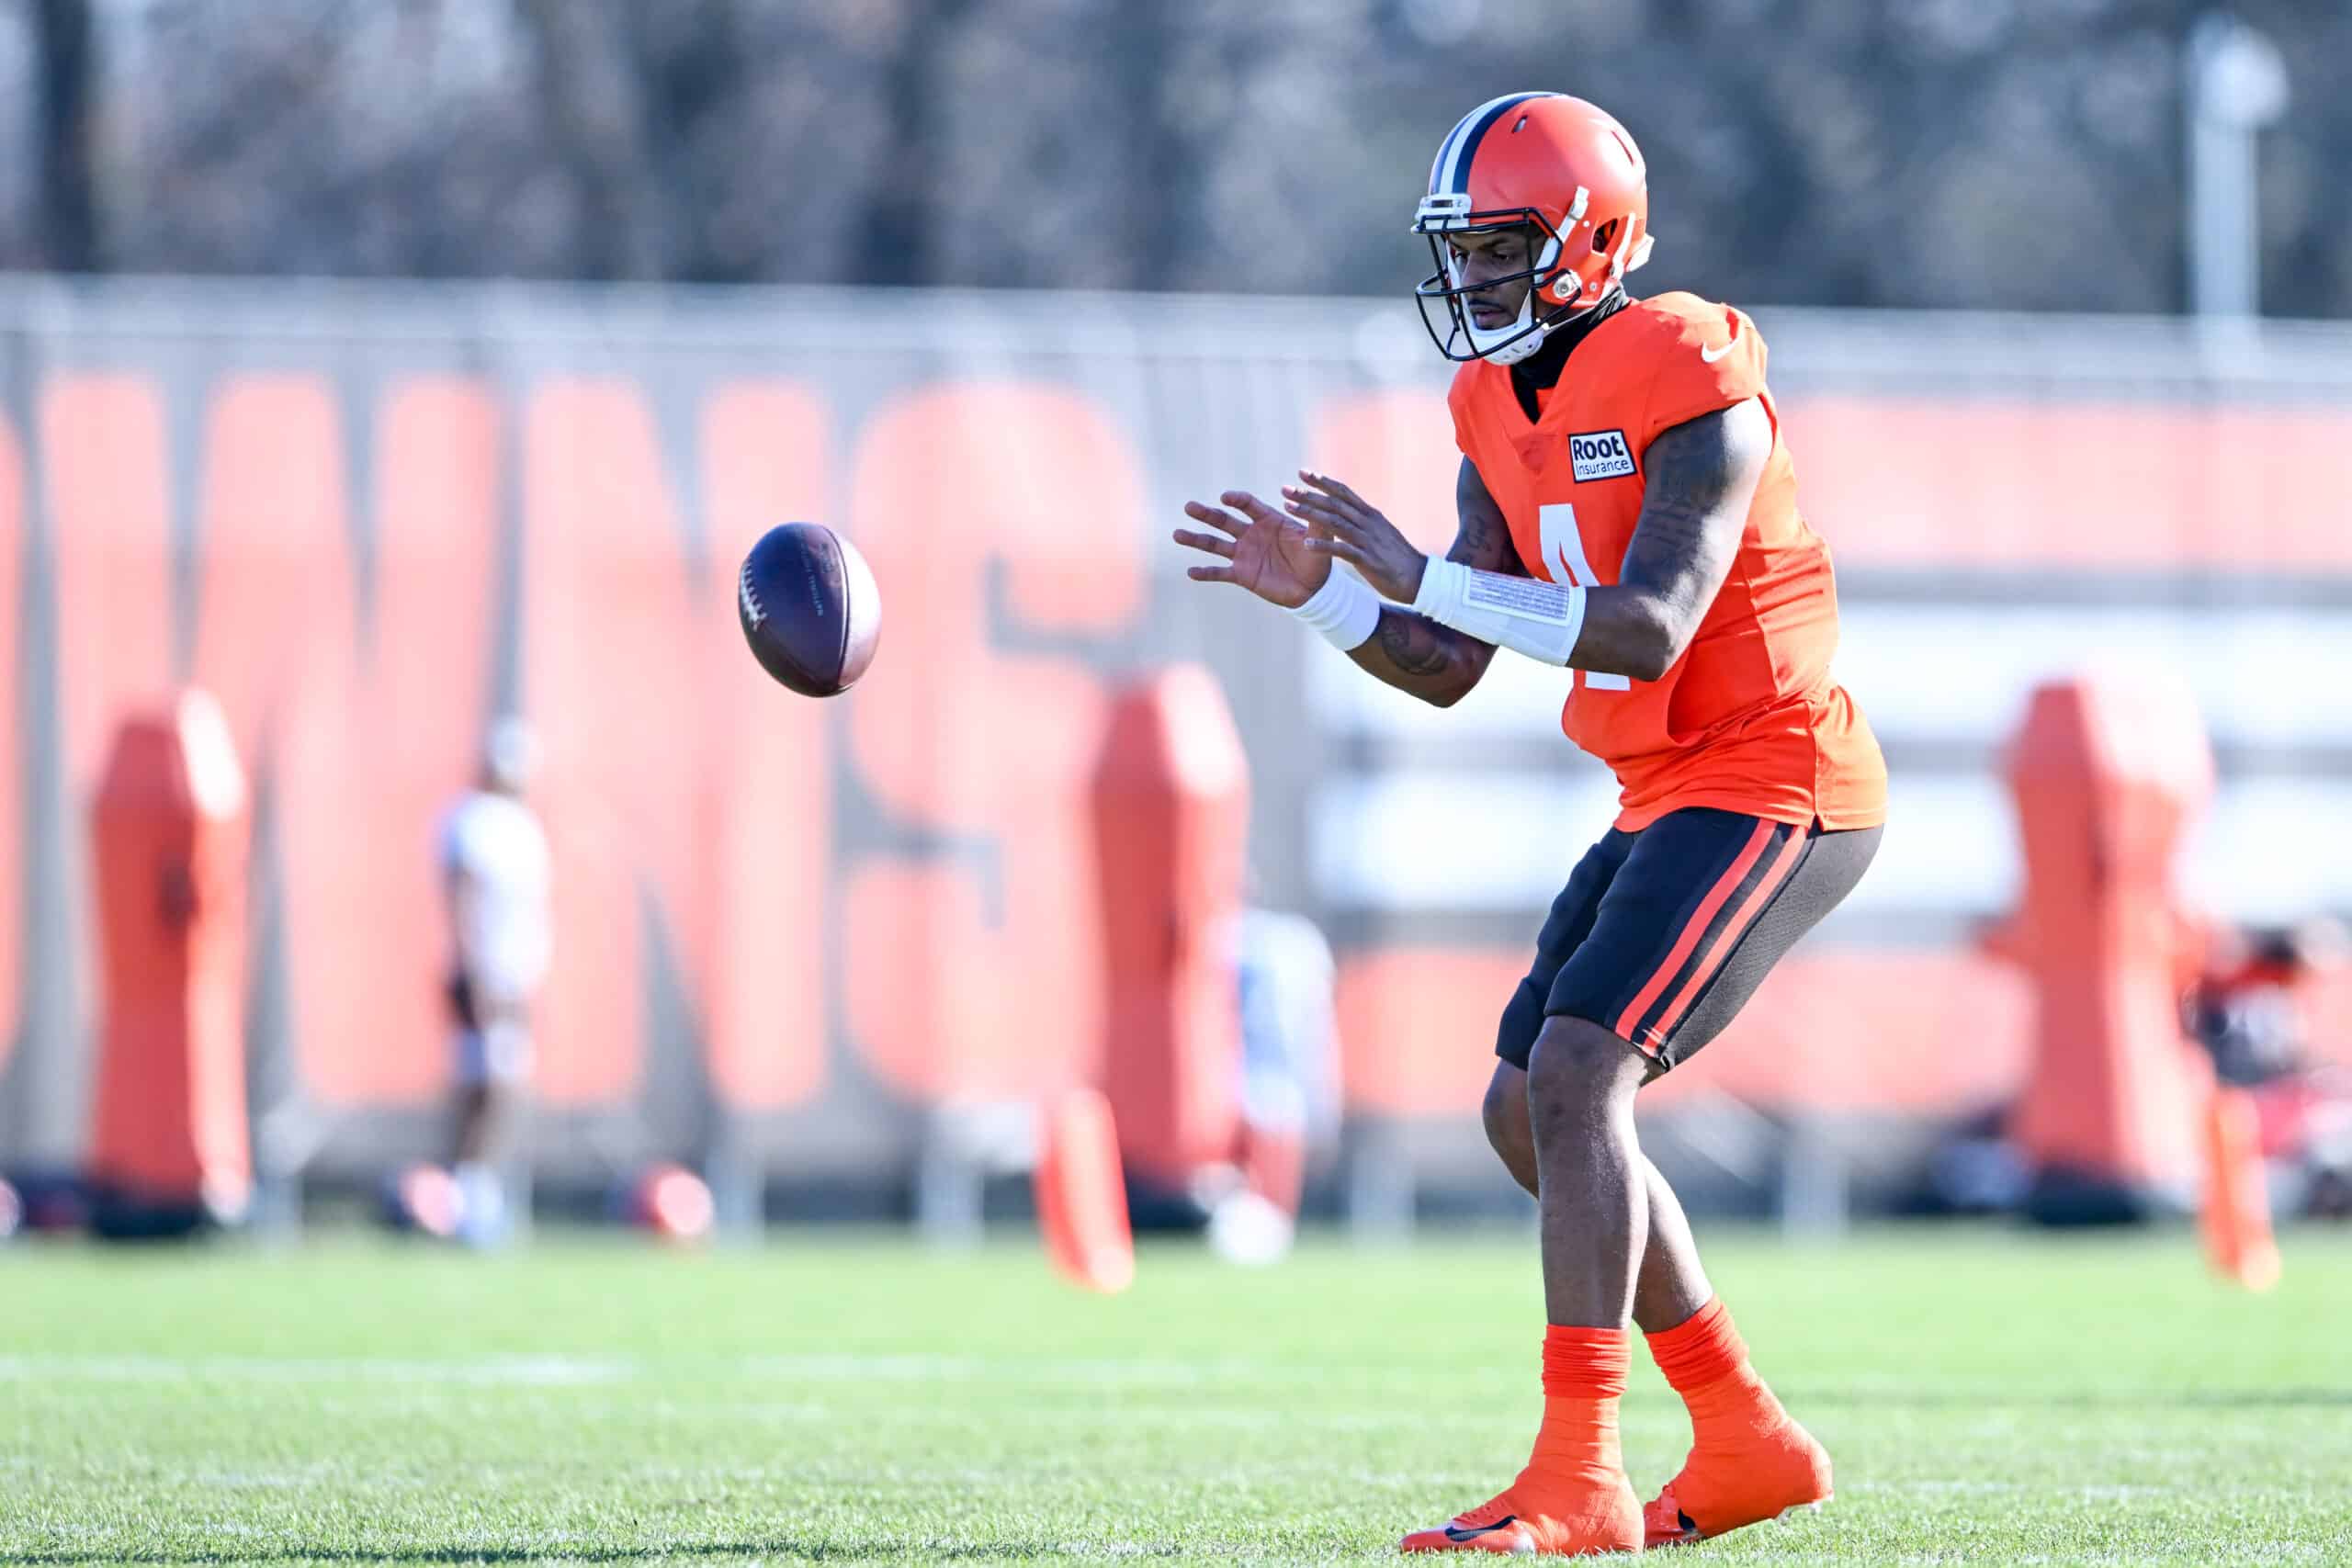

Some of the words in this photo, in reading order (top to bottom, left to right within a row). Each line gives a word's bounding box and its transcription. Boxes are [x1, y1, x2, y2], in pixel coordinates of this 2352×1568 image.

[1572, 435, 1624, 460] Root
[1576, 459, 1629, 476] Insurance
[0, 373, 1148, 1110] WNS
